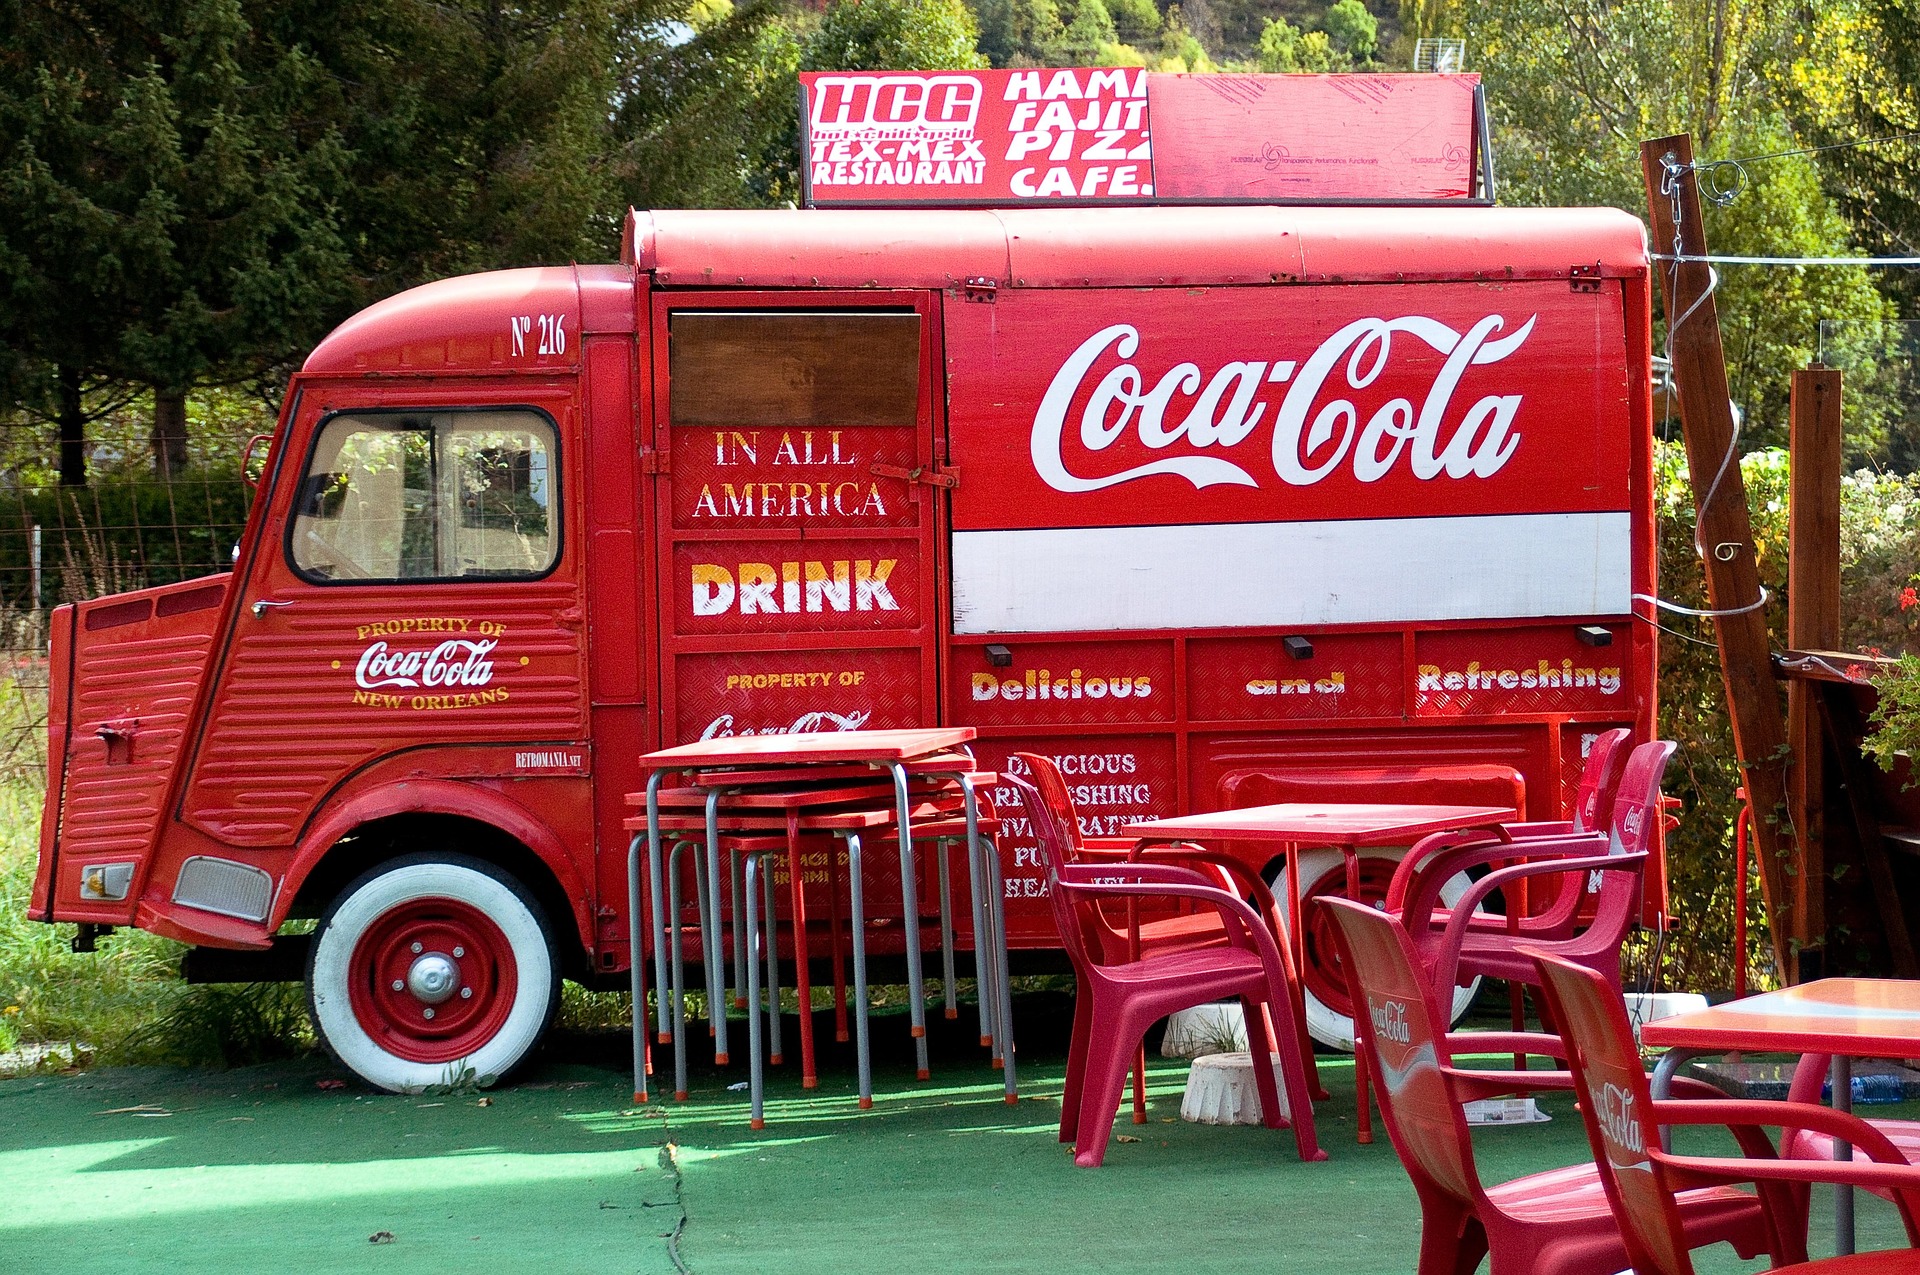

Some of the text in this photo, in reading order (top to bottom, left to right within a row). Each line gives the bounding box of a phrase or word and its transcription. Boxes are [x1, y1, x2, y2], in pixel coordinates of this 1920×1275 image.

[812, 139, 986, 161] TEX-MEX
[812, 161, 986, 185] RESTAURANT
[537, 314, 566, 355] 216
[1030, 312, 1537, 493] Coca-Cola
[713, 430, 856, 466] IN ALL
[691, 482, 889, 517] AMERICA
[691, 558, 900, 617] DRINK
[356, 617, 508, 640] PROPERTY OF
[355, 639, 499, 689] Coca-Cola
[727, 671, 865, 689] PROPERTY OF
[971, 658, 1622, 701] Delicious and Refreshing
[352, 686, 510, 710] NEW ORLEANS
